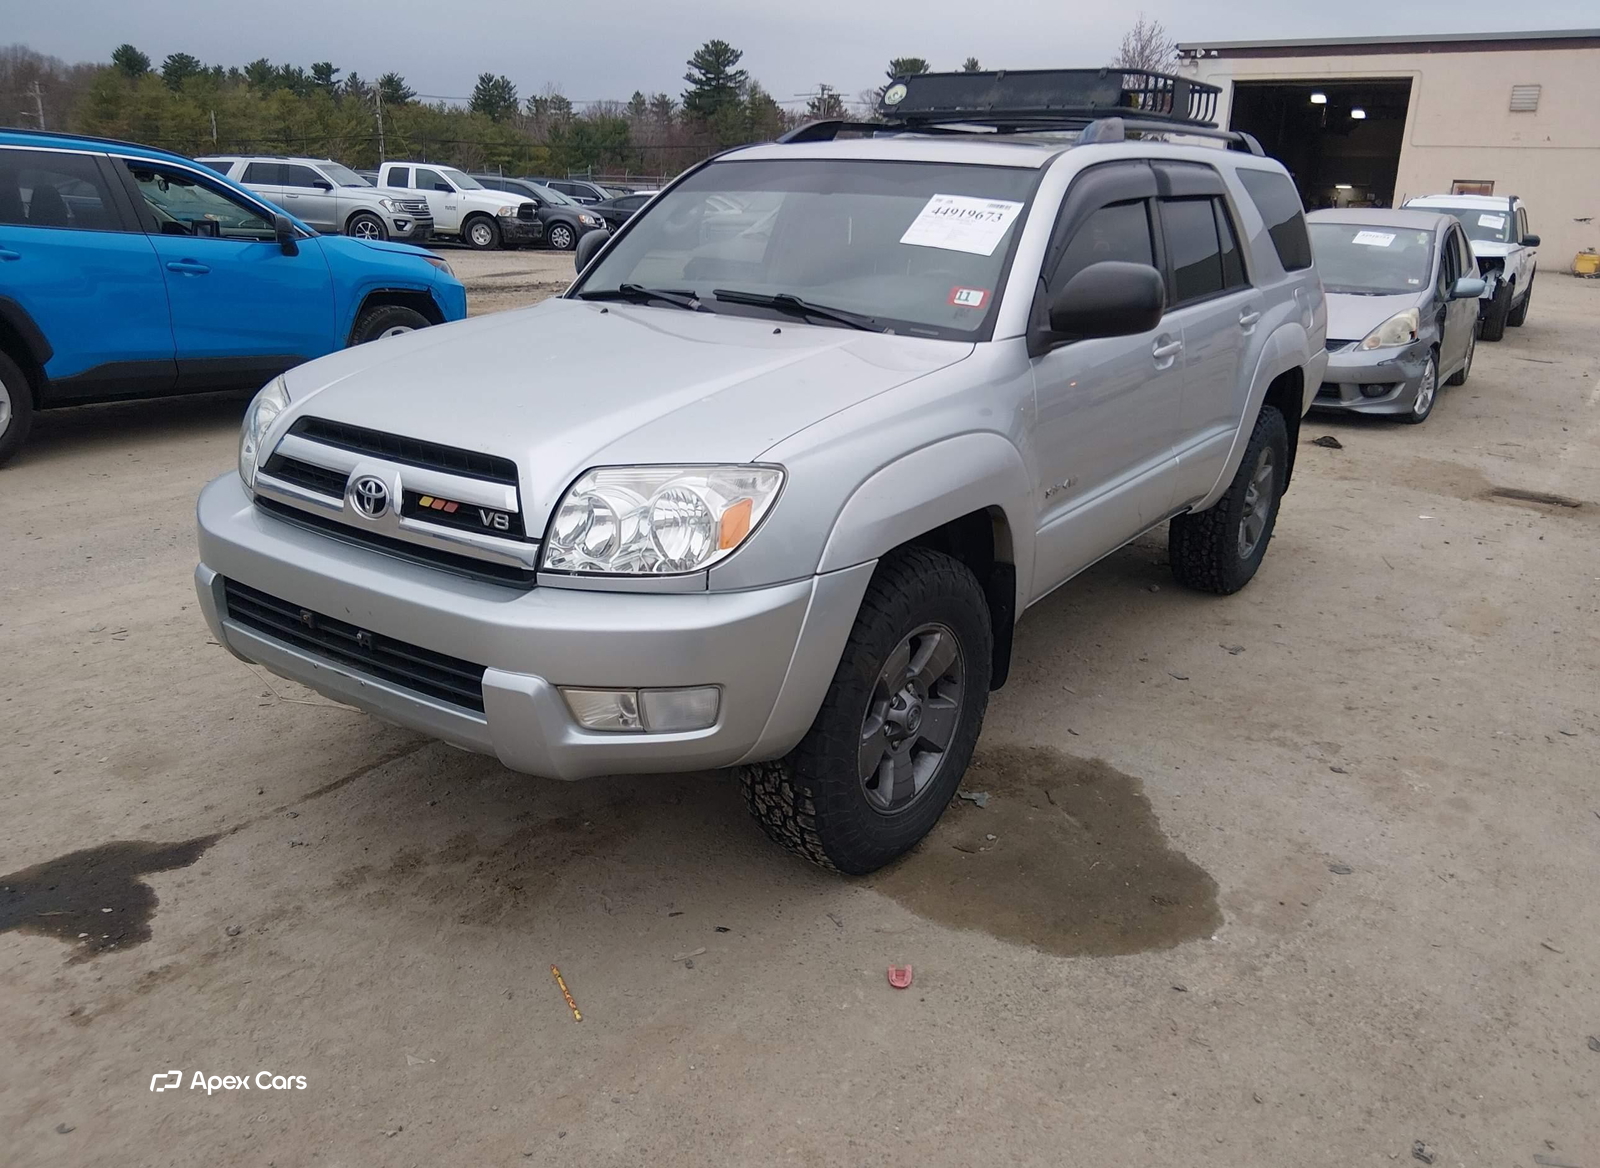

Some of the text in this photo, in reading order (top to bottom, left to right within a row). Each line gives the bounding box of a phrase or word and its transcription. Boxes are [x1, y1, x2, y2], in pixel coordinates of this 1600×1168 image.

[931, 206, 1004, 223] 44919673
[956, 290, 971, 303] 11
[479, 509, 509, 530] V8
